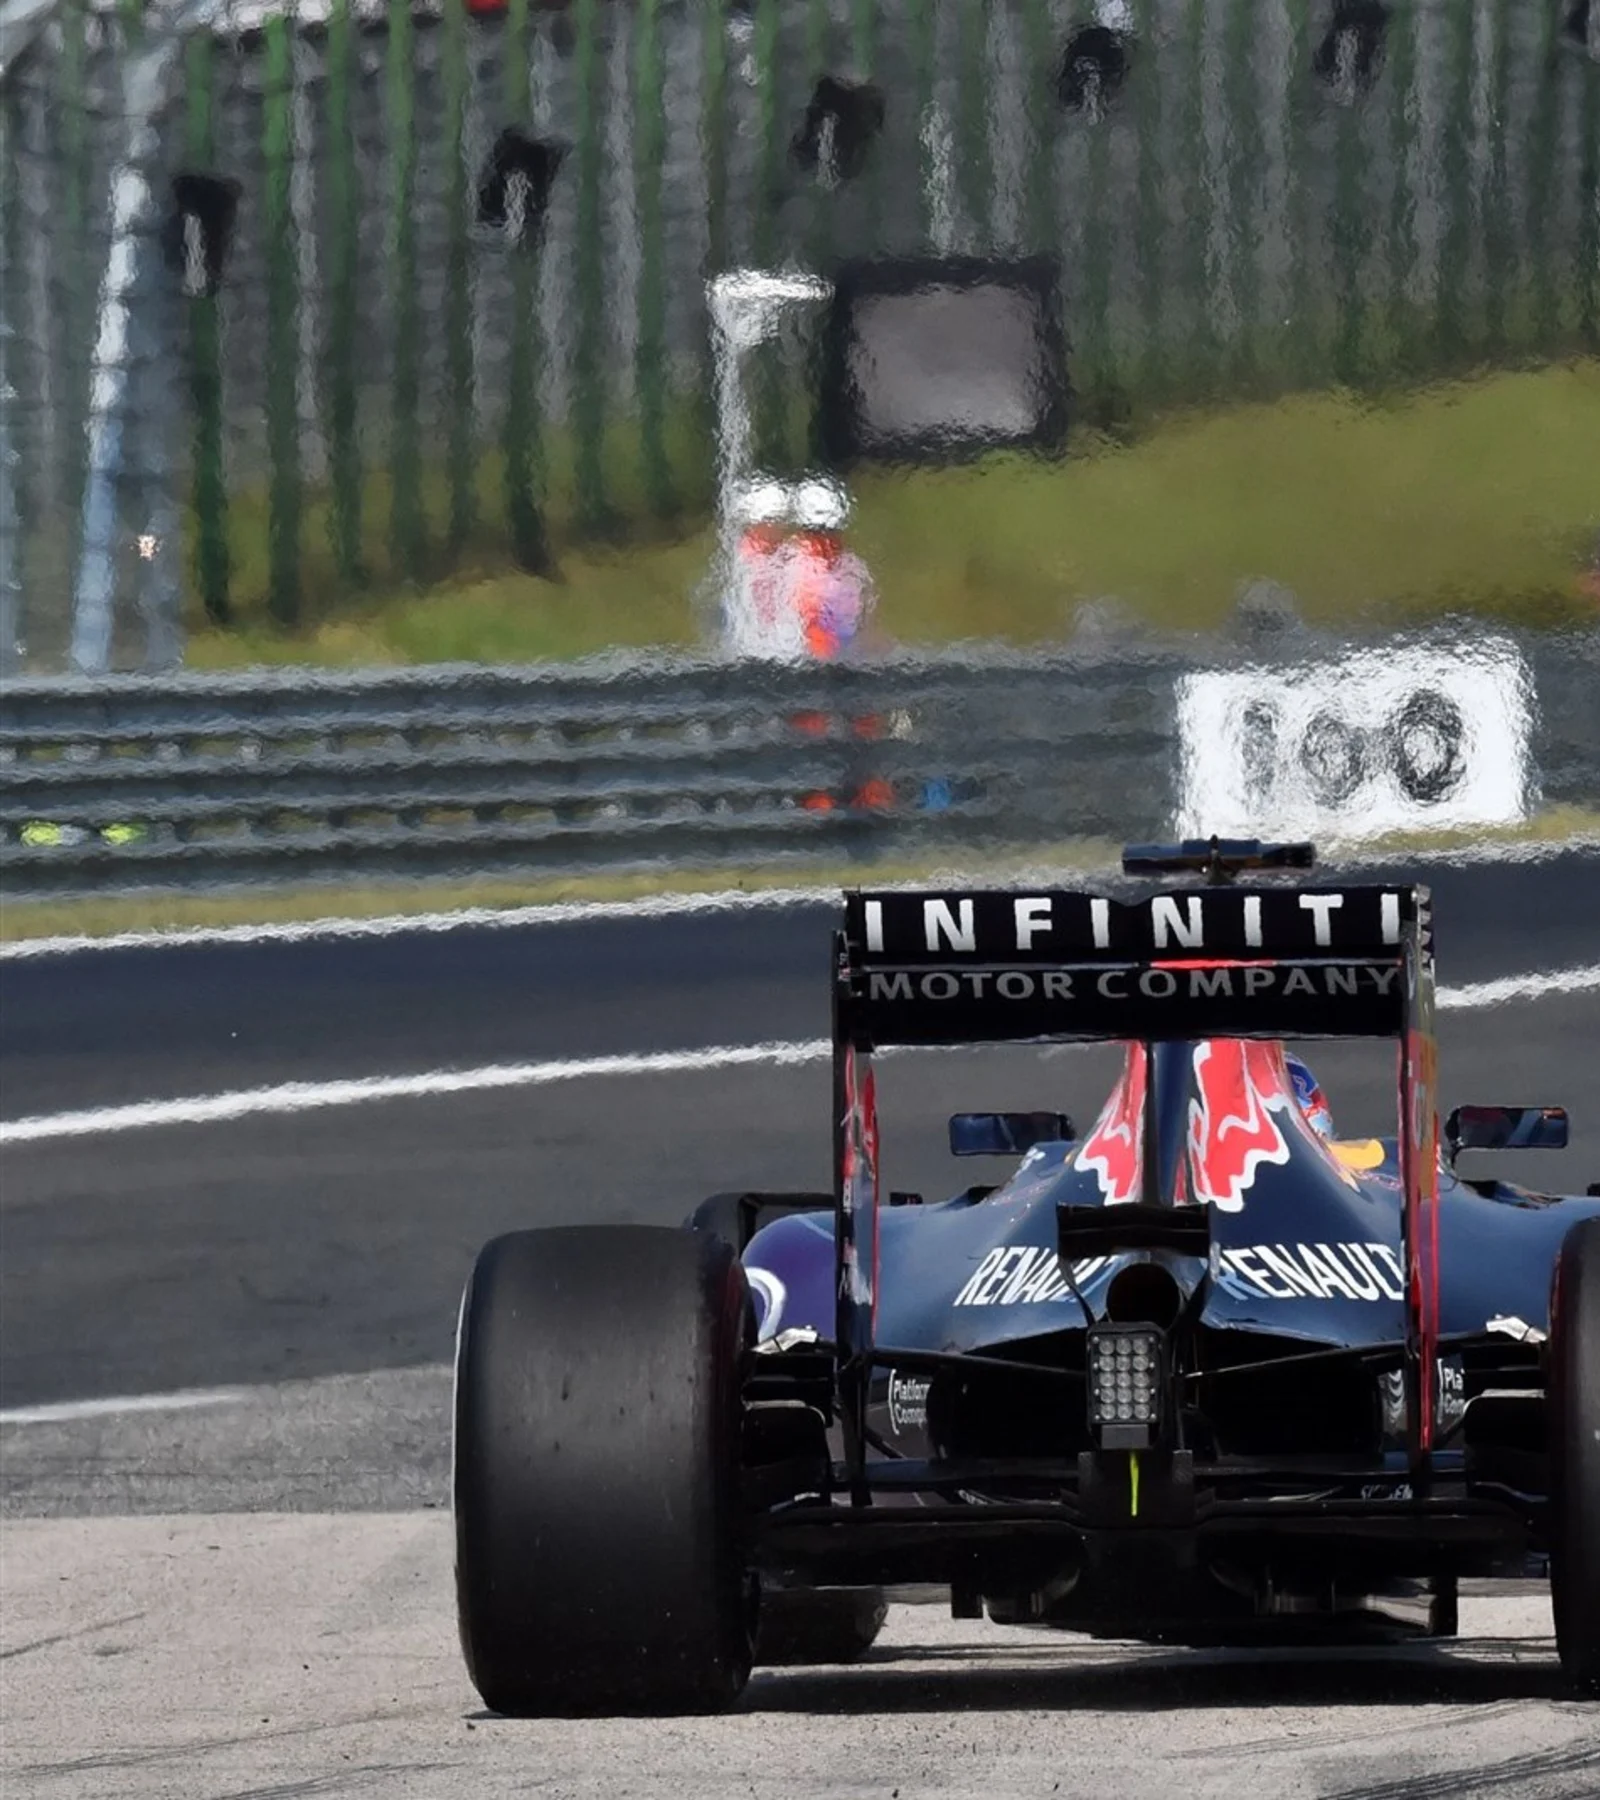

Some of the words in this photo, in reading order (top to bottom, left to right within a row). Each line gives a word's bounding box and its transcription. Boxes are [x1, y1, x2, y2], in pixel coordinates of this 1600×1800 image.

[865, 893, 1400, 952] INFINITI
[869, 971, 1076, 1001] MOTOR
[1095, 966, 1401, 1001] COMPANY
